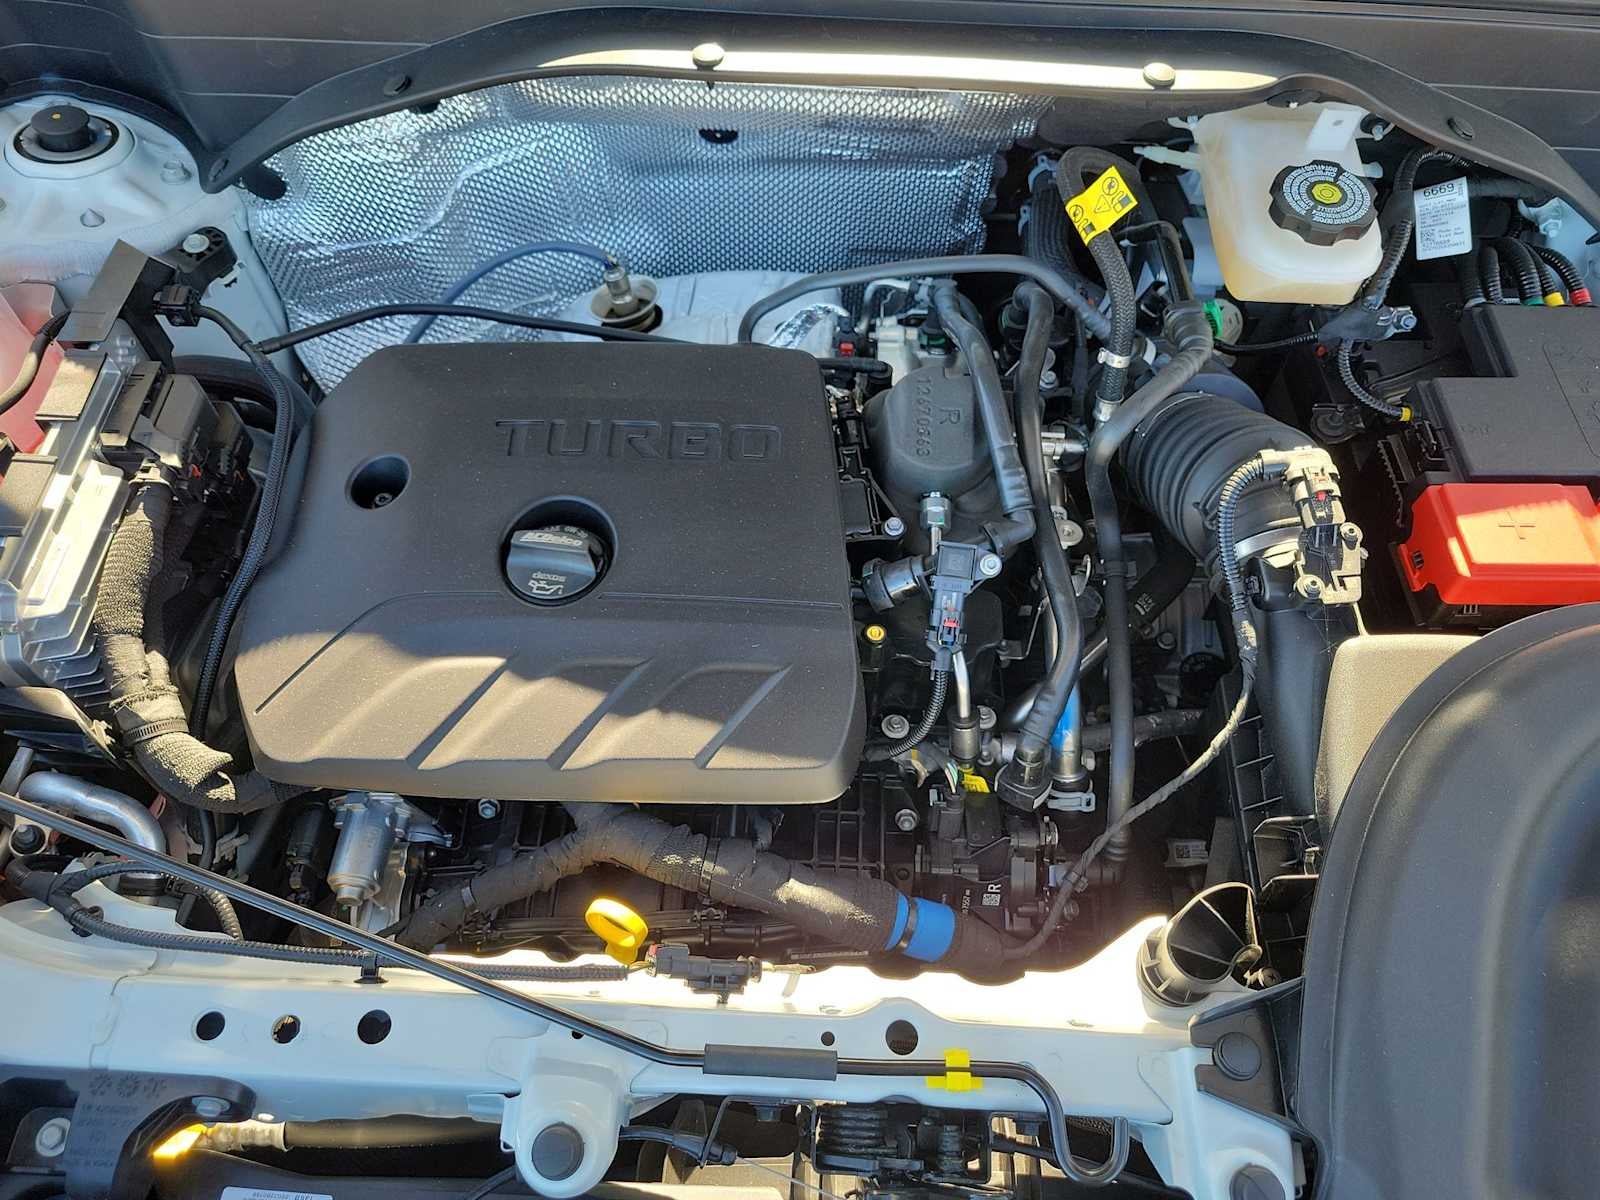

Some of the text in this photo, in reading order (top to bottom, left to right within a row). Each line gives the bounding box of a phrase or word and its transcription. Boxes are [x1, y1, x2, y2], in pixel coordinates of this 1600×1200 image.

[1423, 183, 1455, 198] 6669
[939, 408, 961, 425] R
[495, 418, 783, 461] TURBO
[988, 884, 1001, 892] R
